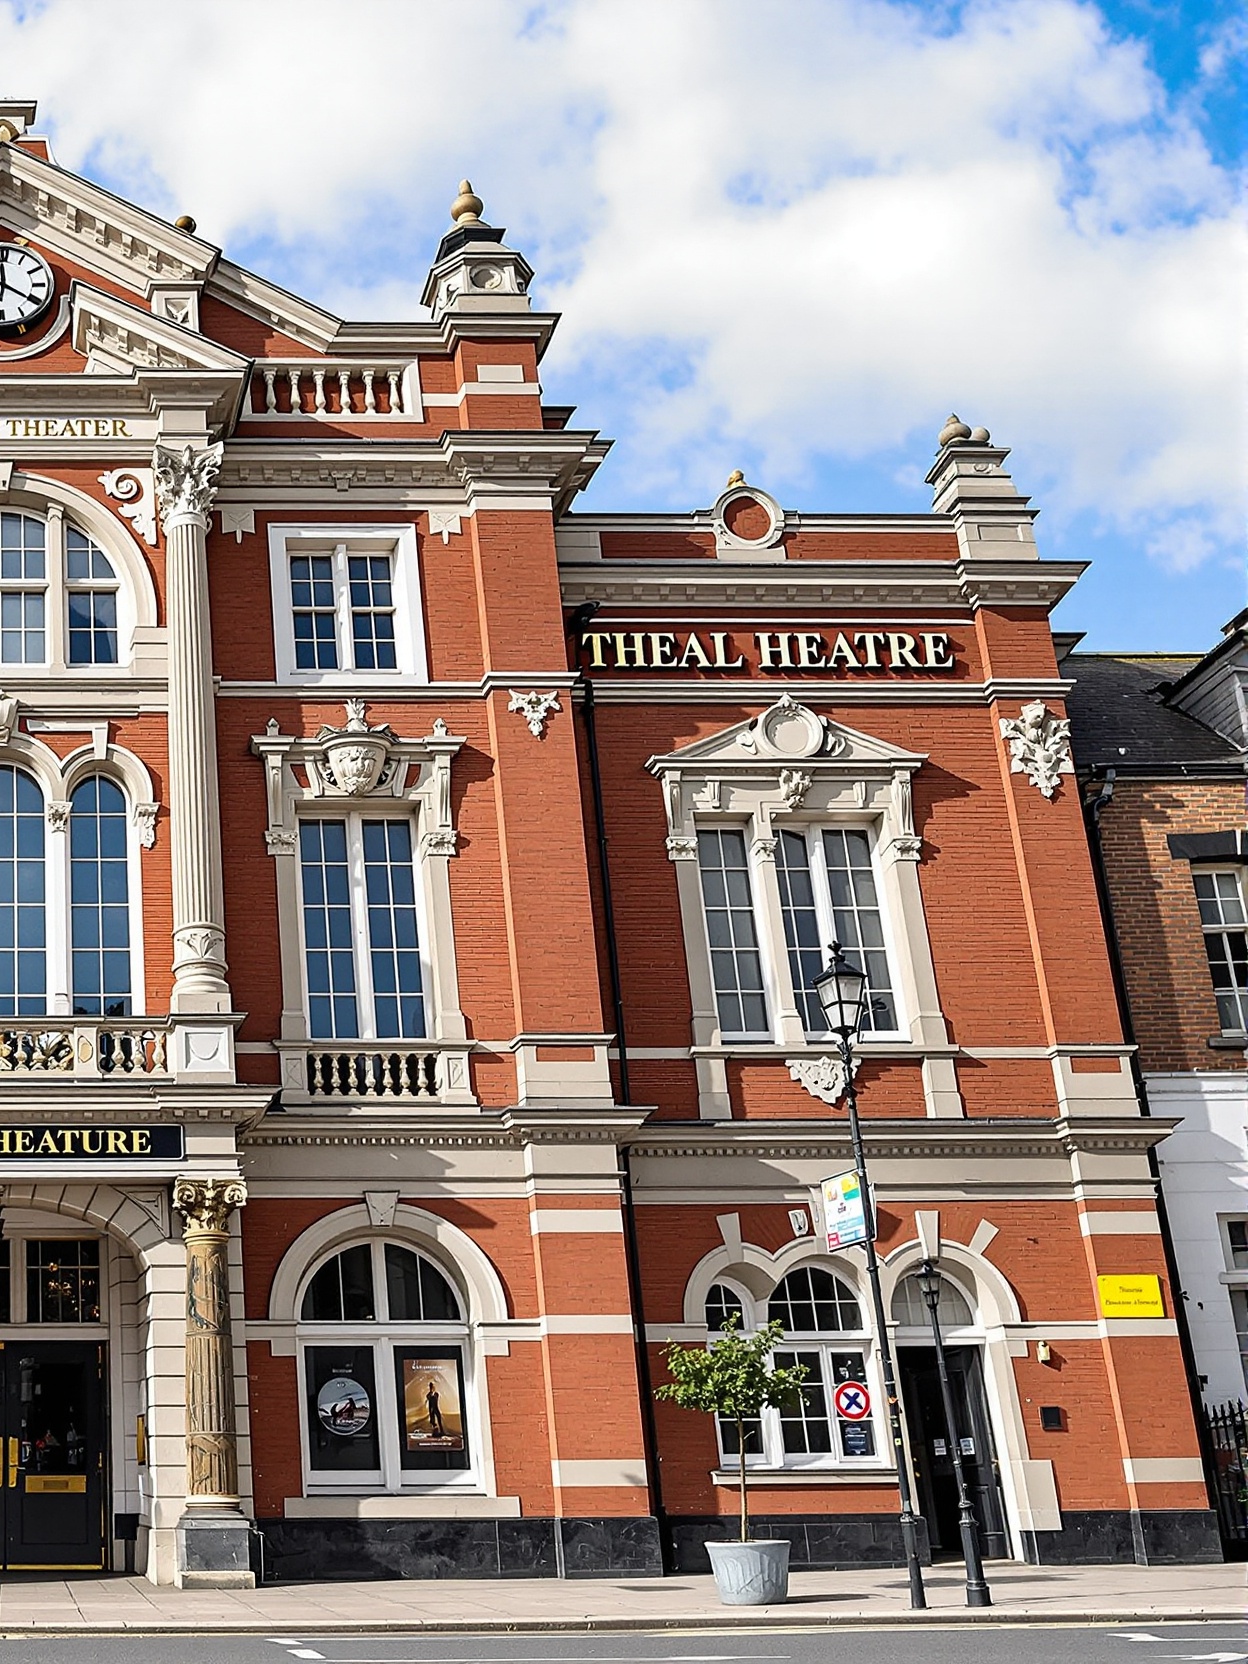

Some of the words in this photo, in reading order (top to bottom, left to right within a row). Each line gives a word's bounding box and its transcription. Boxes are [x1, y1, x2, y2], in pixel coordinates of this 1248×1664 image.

[6, 418, 133, 437] THEATER
[582, 632, 744, 668] THEAL
[755, 631, 954, 668] HEATRE
